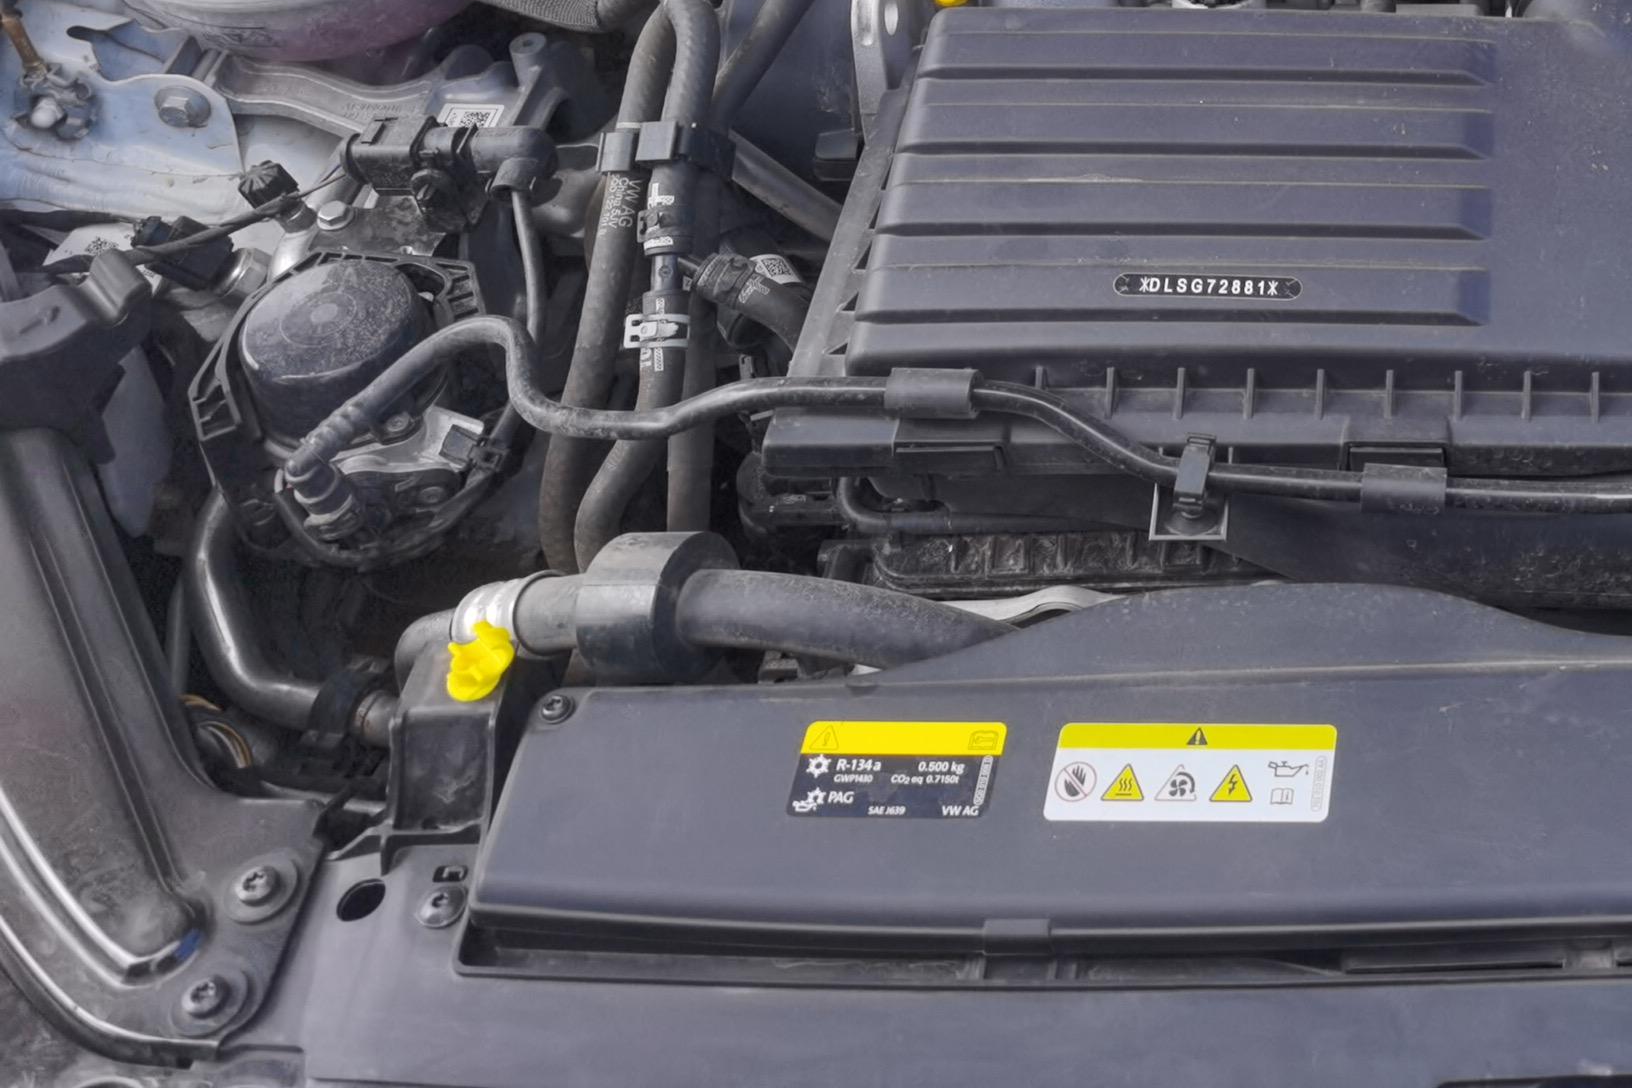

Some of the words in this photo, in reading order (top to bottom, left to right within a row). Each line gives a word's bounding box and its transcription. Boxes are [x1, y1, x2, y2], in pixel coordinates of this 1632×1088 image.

[614, 177, 629, 207] China
[624, 179, 644, 203] VW
[618, 205, 635, 227] AG
[918, 761, 949, 772] 0.500
[951, 761, 965, 774] kg
[911, 776, 924, 784] eq
[828, 791, 855, 804] PAG
[868, 806, 885, 815] SAE
[885, 806, 906, 815] J639
[942, 805, 961, 816] VW
[962, 805, 979, 816] AG
